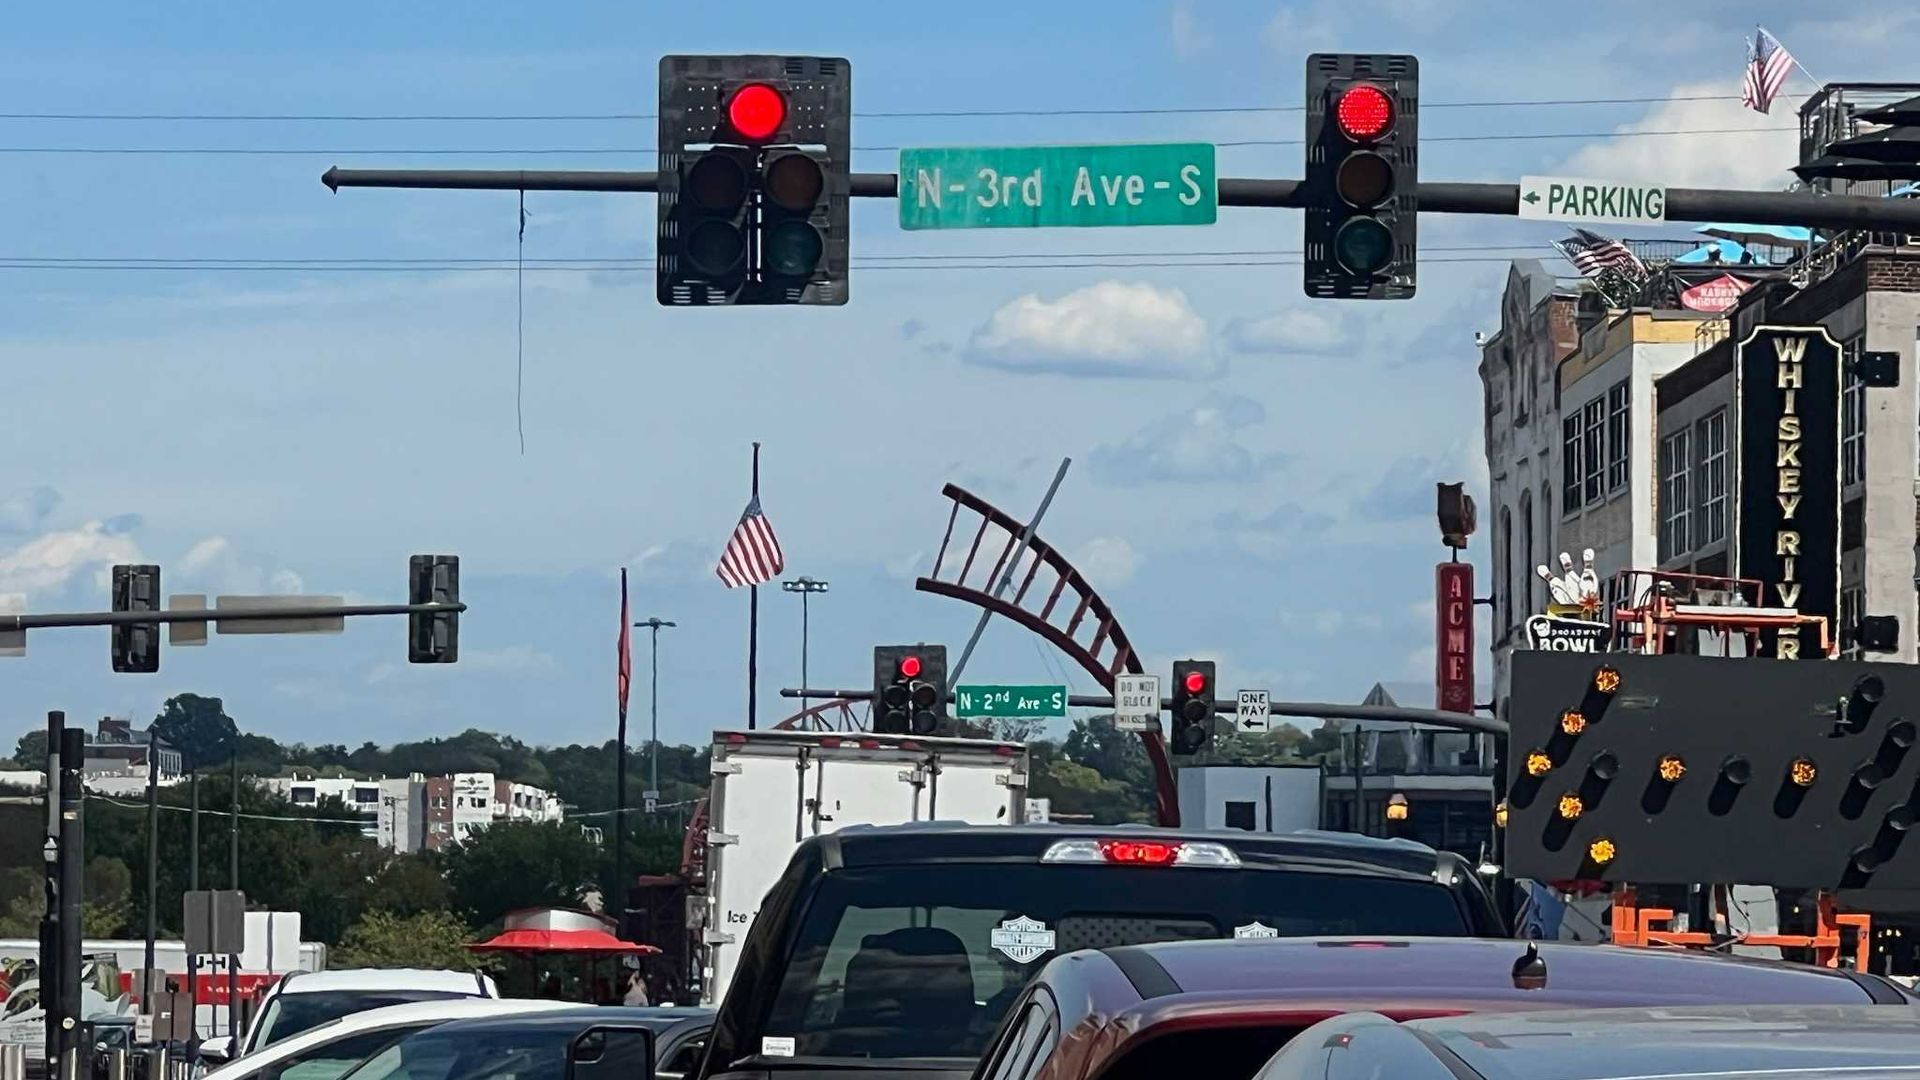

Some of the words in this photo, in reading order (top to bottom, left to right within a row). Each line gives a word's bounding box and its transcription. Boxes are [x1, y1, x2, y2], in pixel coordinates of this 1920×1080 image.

[1548, 183, 1663, 220] PARKING
[1773, 337, 1808, 519] WHISKEY
[1447, 574, 1466, 682] ACME
[1539, 637, 1601, 654] BOWL
[1241, 693, 1266, 704] ONE
[1241, 705, 1267, 716] WAY
[727, 909, 748, 924] Ice
